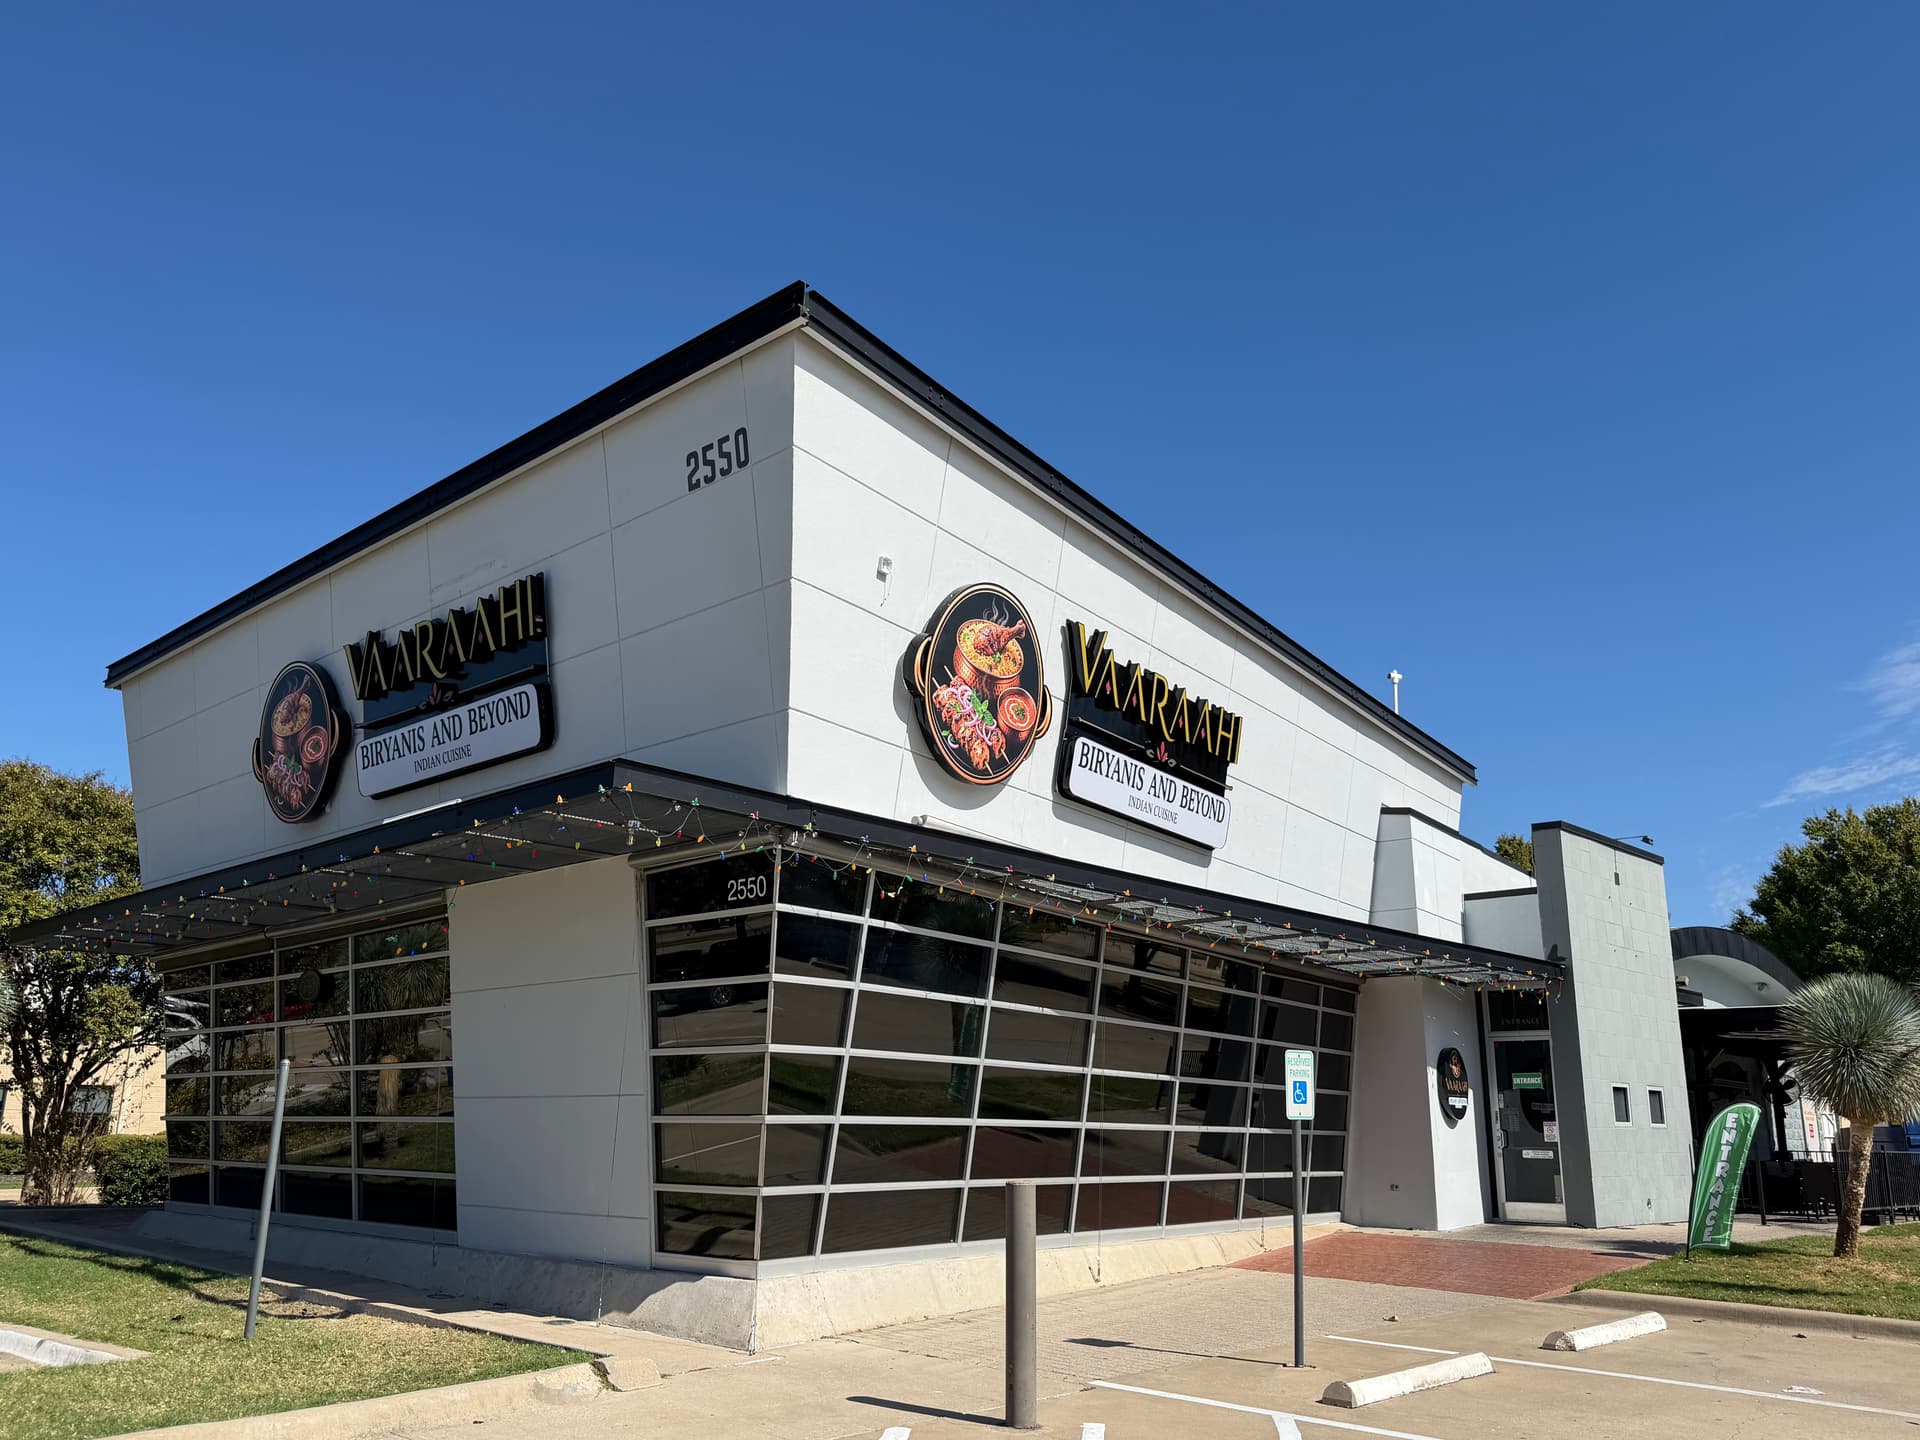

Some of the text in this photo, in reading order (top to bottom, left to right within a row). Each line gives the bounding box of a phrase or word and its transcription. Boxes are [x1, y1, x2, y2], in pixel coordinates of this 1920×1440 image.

[686, 427, 749, 492] 2550
[343, 573, 536, 699] VAARAAHI
[361, 690, 531, 770] BIRYANIS AND BEYOND
[1078, 622, 1243, 765] VAARAAHI
[414, 744, 472, 773] INDIAN CUISINE
[1078, 742, 1226, 823] BIRYANIS AND BEYOND
[1128, 795, 1178, 824] INDIAN CUISINE
[728, 875, 767, 901] 2550
[1702, 1112, 1739, 1243] ENTRANCE
